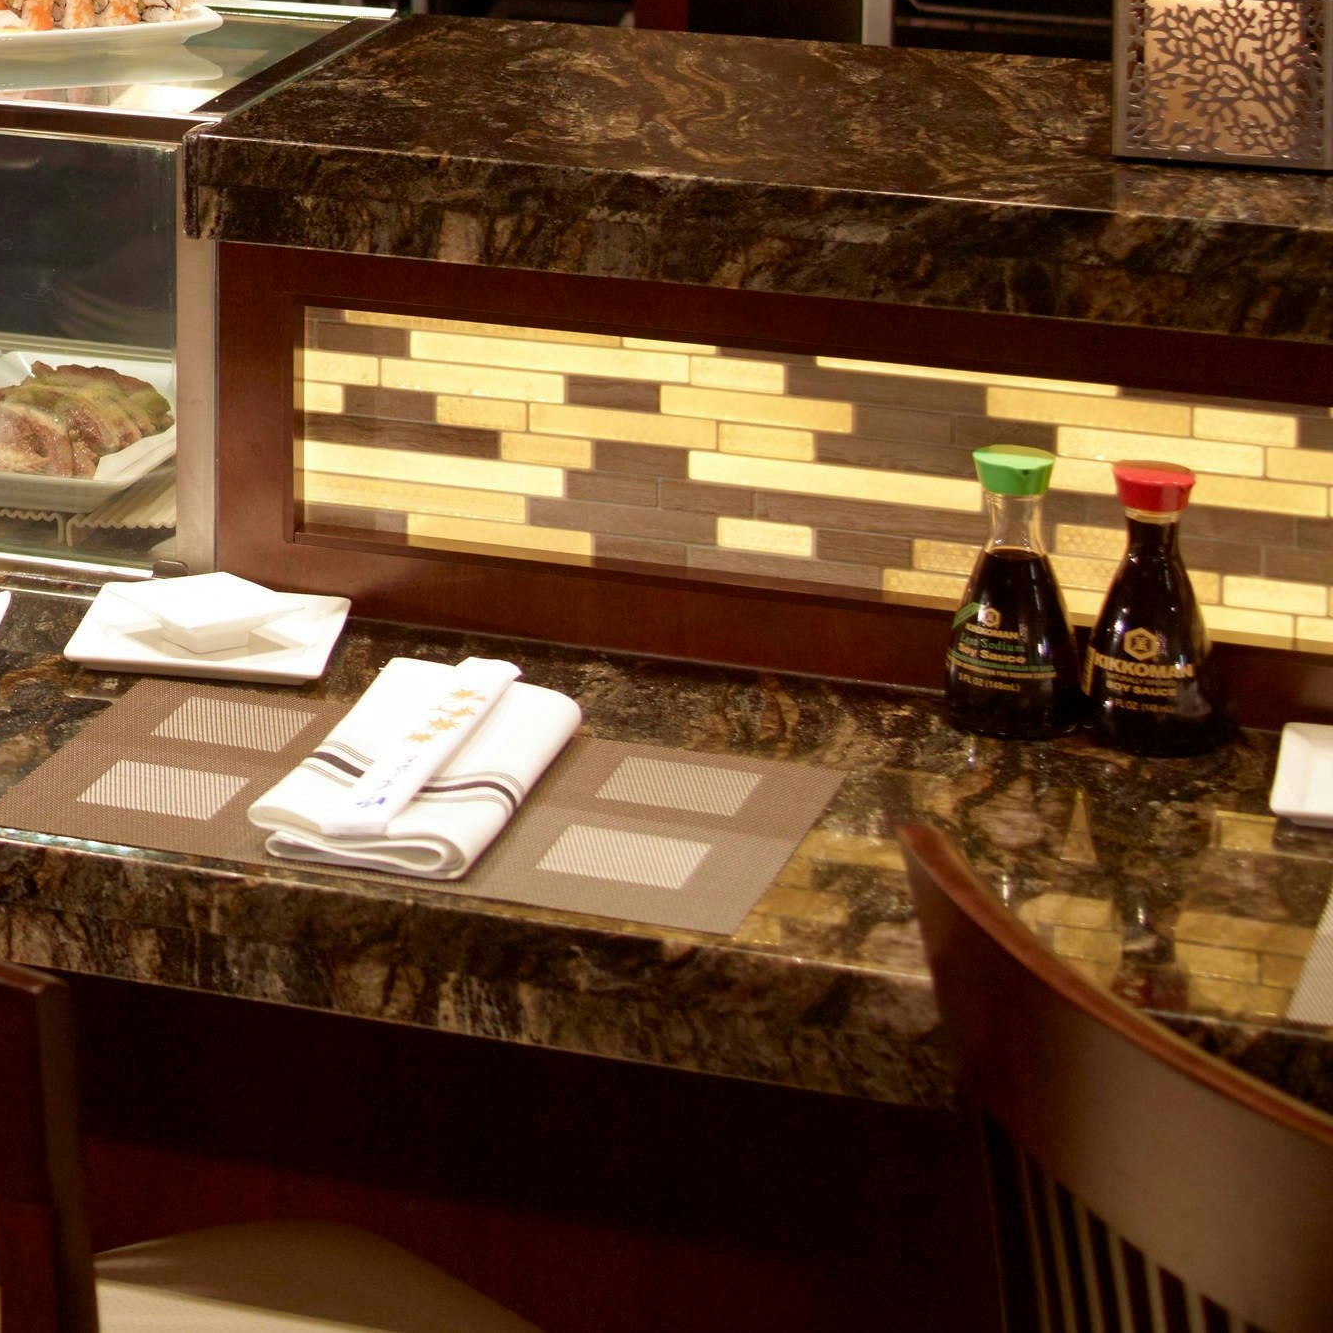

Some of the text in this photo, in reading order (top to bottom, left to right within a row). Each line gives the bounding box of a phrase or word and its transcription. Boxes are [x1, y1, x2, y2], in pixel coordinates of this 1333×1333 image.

[980, 638, 1025, 653] Sodium
[979, 650, 1027, 665] Sauce
[1091, 649, 1194, 680] KIKKOMAN
[1105, 680, 1177, 697] SOY SAUCE
